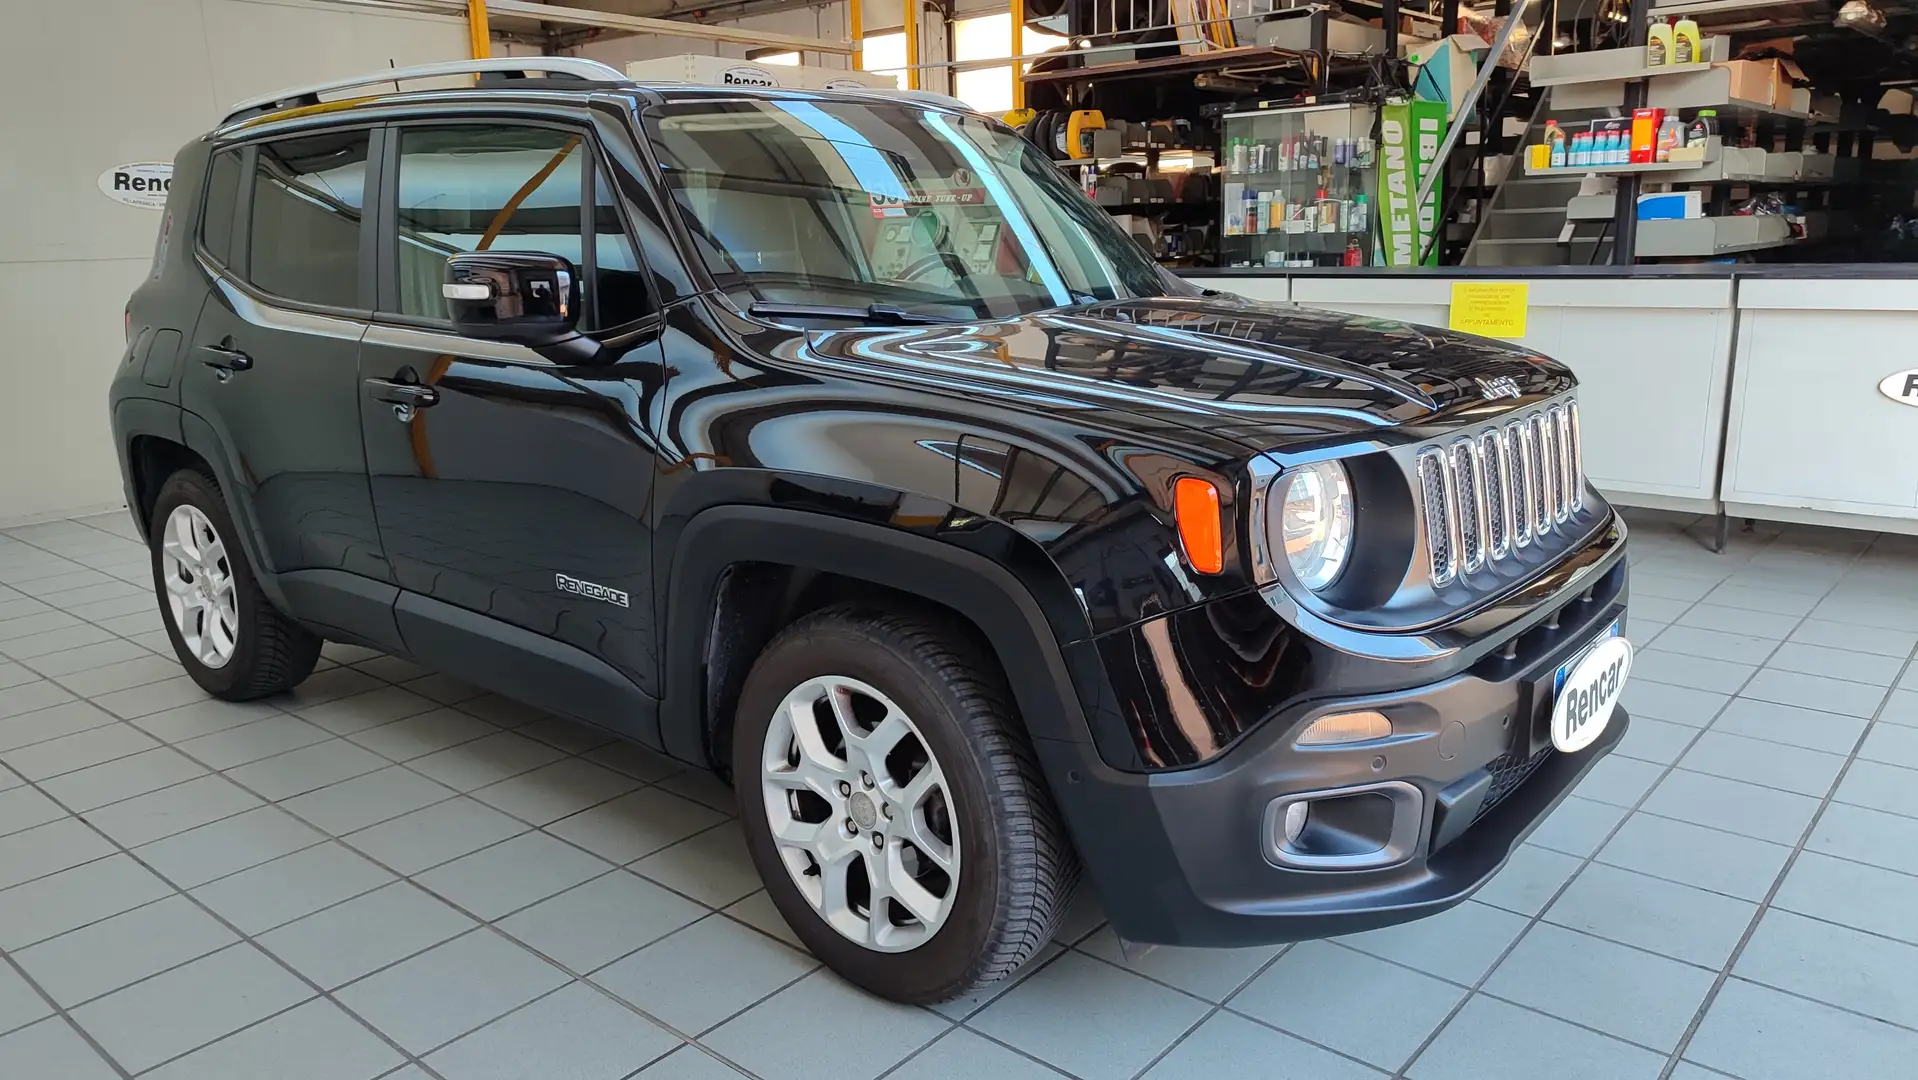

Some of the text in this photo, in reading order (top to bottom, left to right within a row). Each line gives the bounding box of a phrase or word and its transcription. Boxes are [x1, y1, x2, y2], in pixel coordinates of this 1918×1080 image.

[935, 193, 973, 203] TUNE-UP
[1382, 120, 1412, 265] METANO
[556, 573, 629, 608] RENEGADE
[1565, 654, 1625, 741] Rencar
